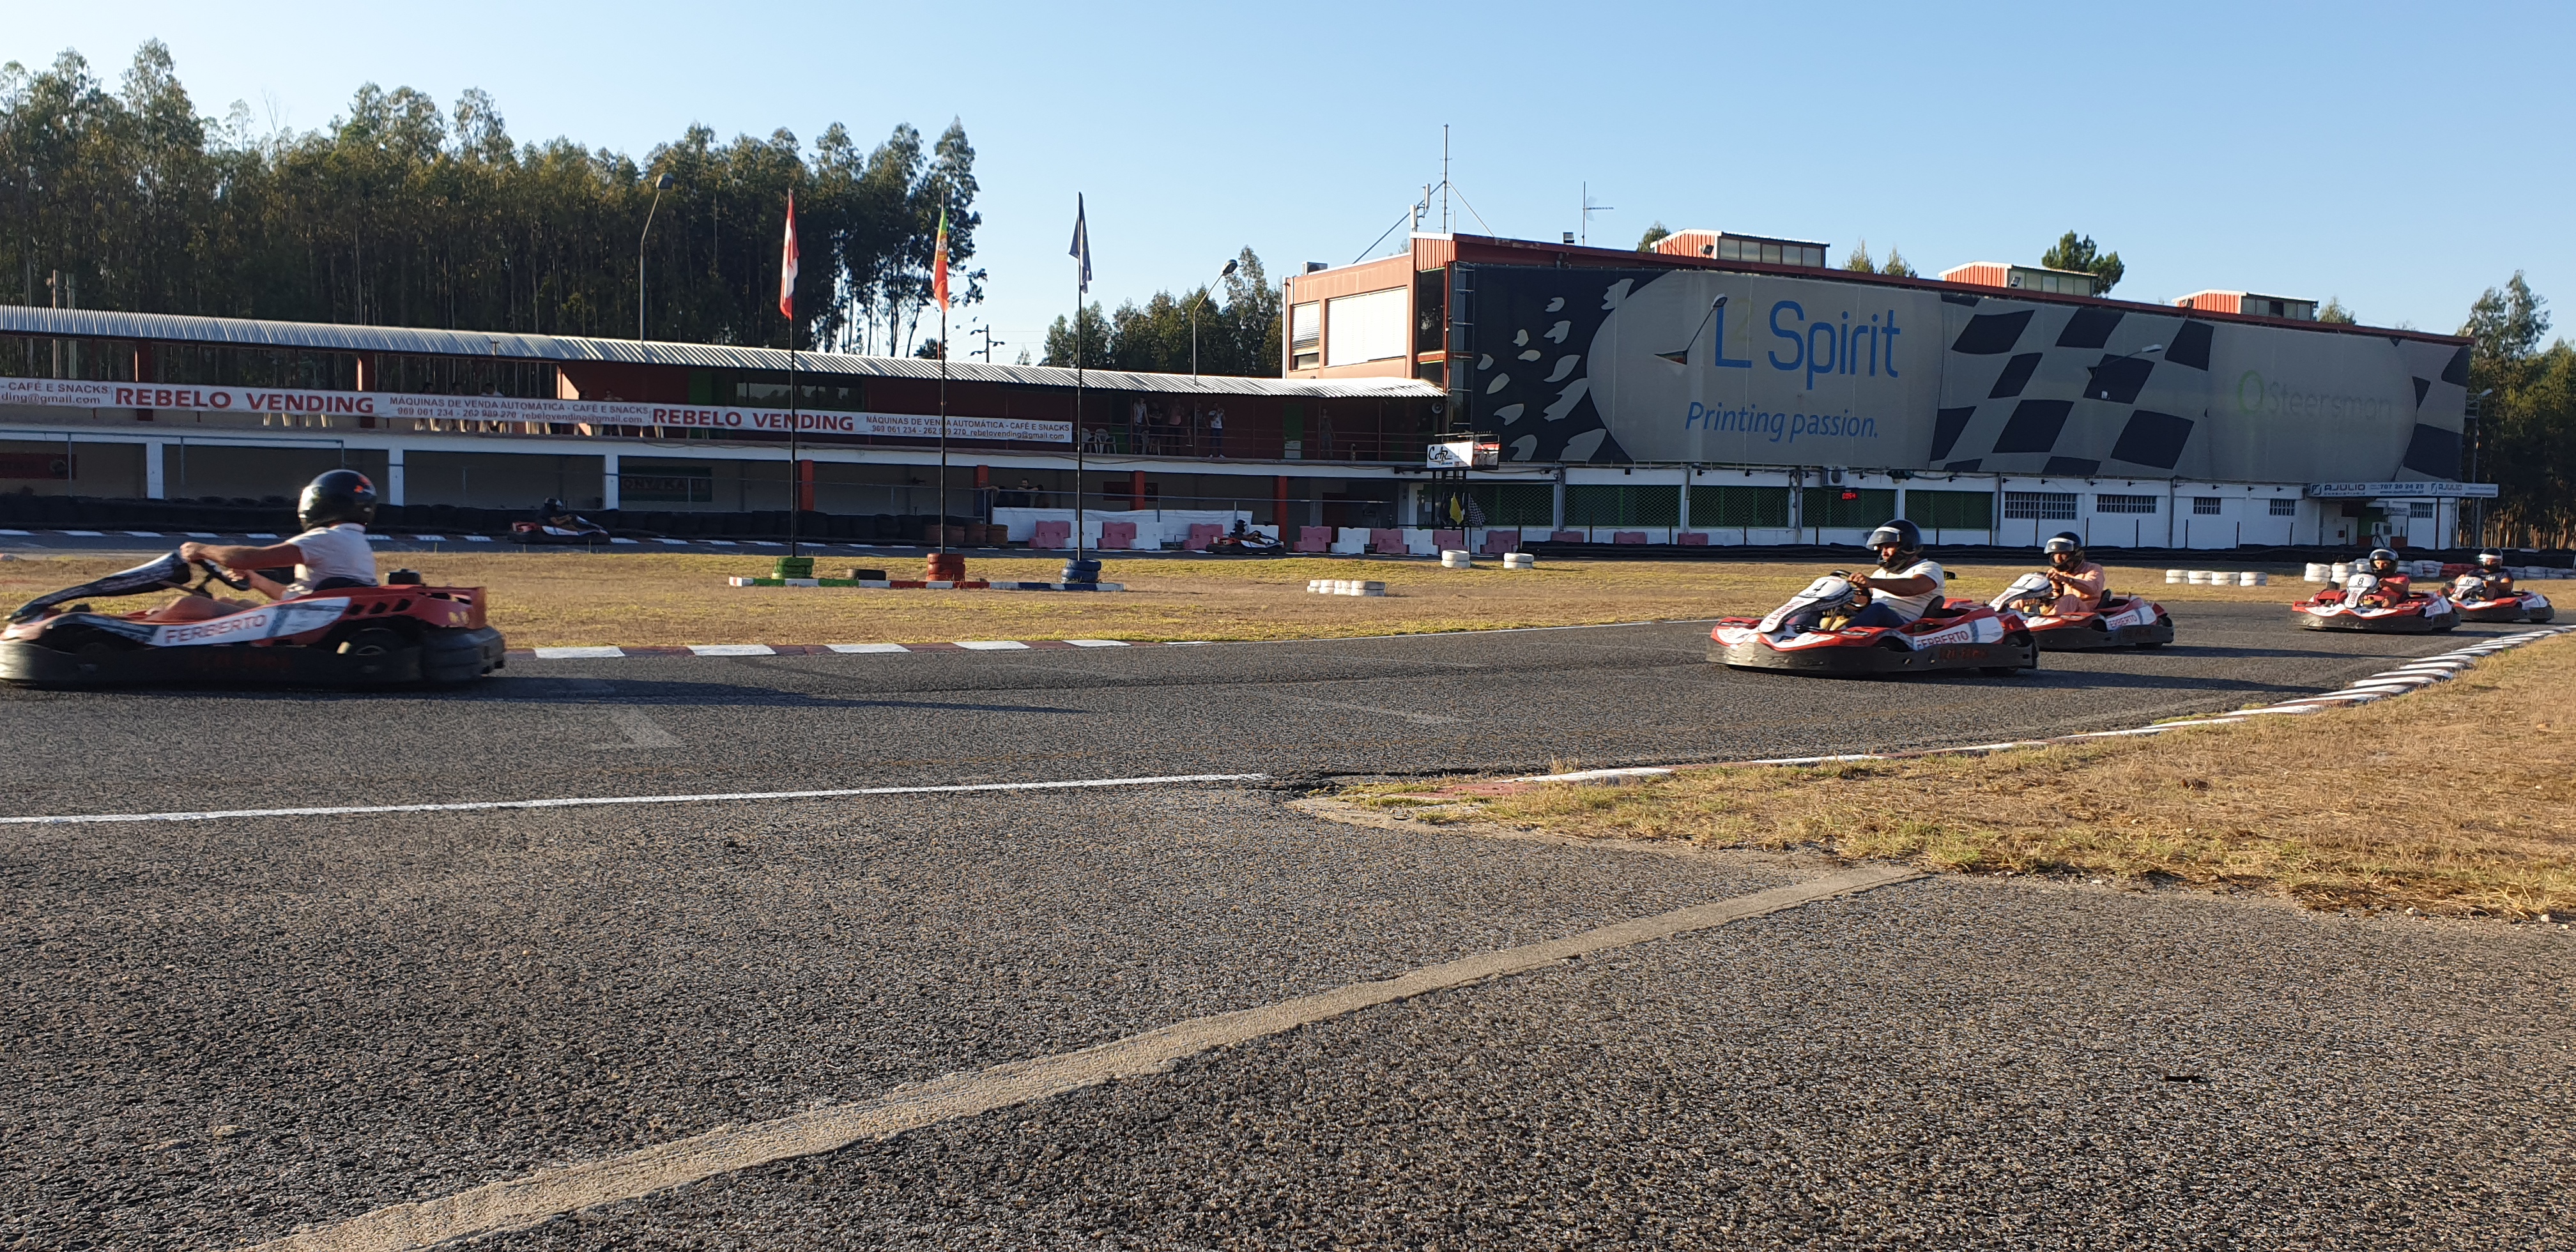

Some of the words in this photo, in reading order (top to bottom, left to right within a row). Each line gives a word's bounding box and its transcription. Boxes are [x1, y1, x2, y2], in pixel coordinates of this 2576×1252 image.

[1768, 300, 1901, 390] Spirit
[8, 380, 42, 392] CAFÉ
[58, 383, 108, 394] SNACKS
[116, 388, 231, 409] REBELO
[246, 392, 374, 413] VENDING
[390, 395, 445, 406] MÁQUINAS
[448, 399, 462, 408] DE
[464, 400, 499, 408] VENDA
[501, 401, 565, 411] AUTOMÁTICA
[572, 404, 598, 413] CAFÉ
[610, 406, 648, 414] SNACKS
[522, 411, 642, 423] rebelovending@gmail.com
[653, 408, 742, 427] REBELO
[753, 412, 854, 431] VENDING
[866, 415, 908, 425] MÁQUINAS
[953, 419, 1004, 429] AUTOMÁTICA
[1010, 422, 1029, 430] CAFÉ
[1685, 402, 1786, 442] Printing
[1789, 409, 1878, 443] passion.
[970, 429, 1064, 439] rebelovending@gmail.com
[1813, 581, 1828, 593] 4
[2021, 577, 2034, 587] 1
[2358, 577, 2364, 586] 8
[165, 615, 266, 644] FERBERTO
